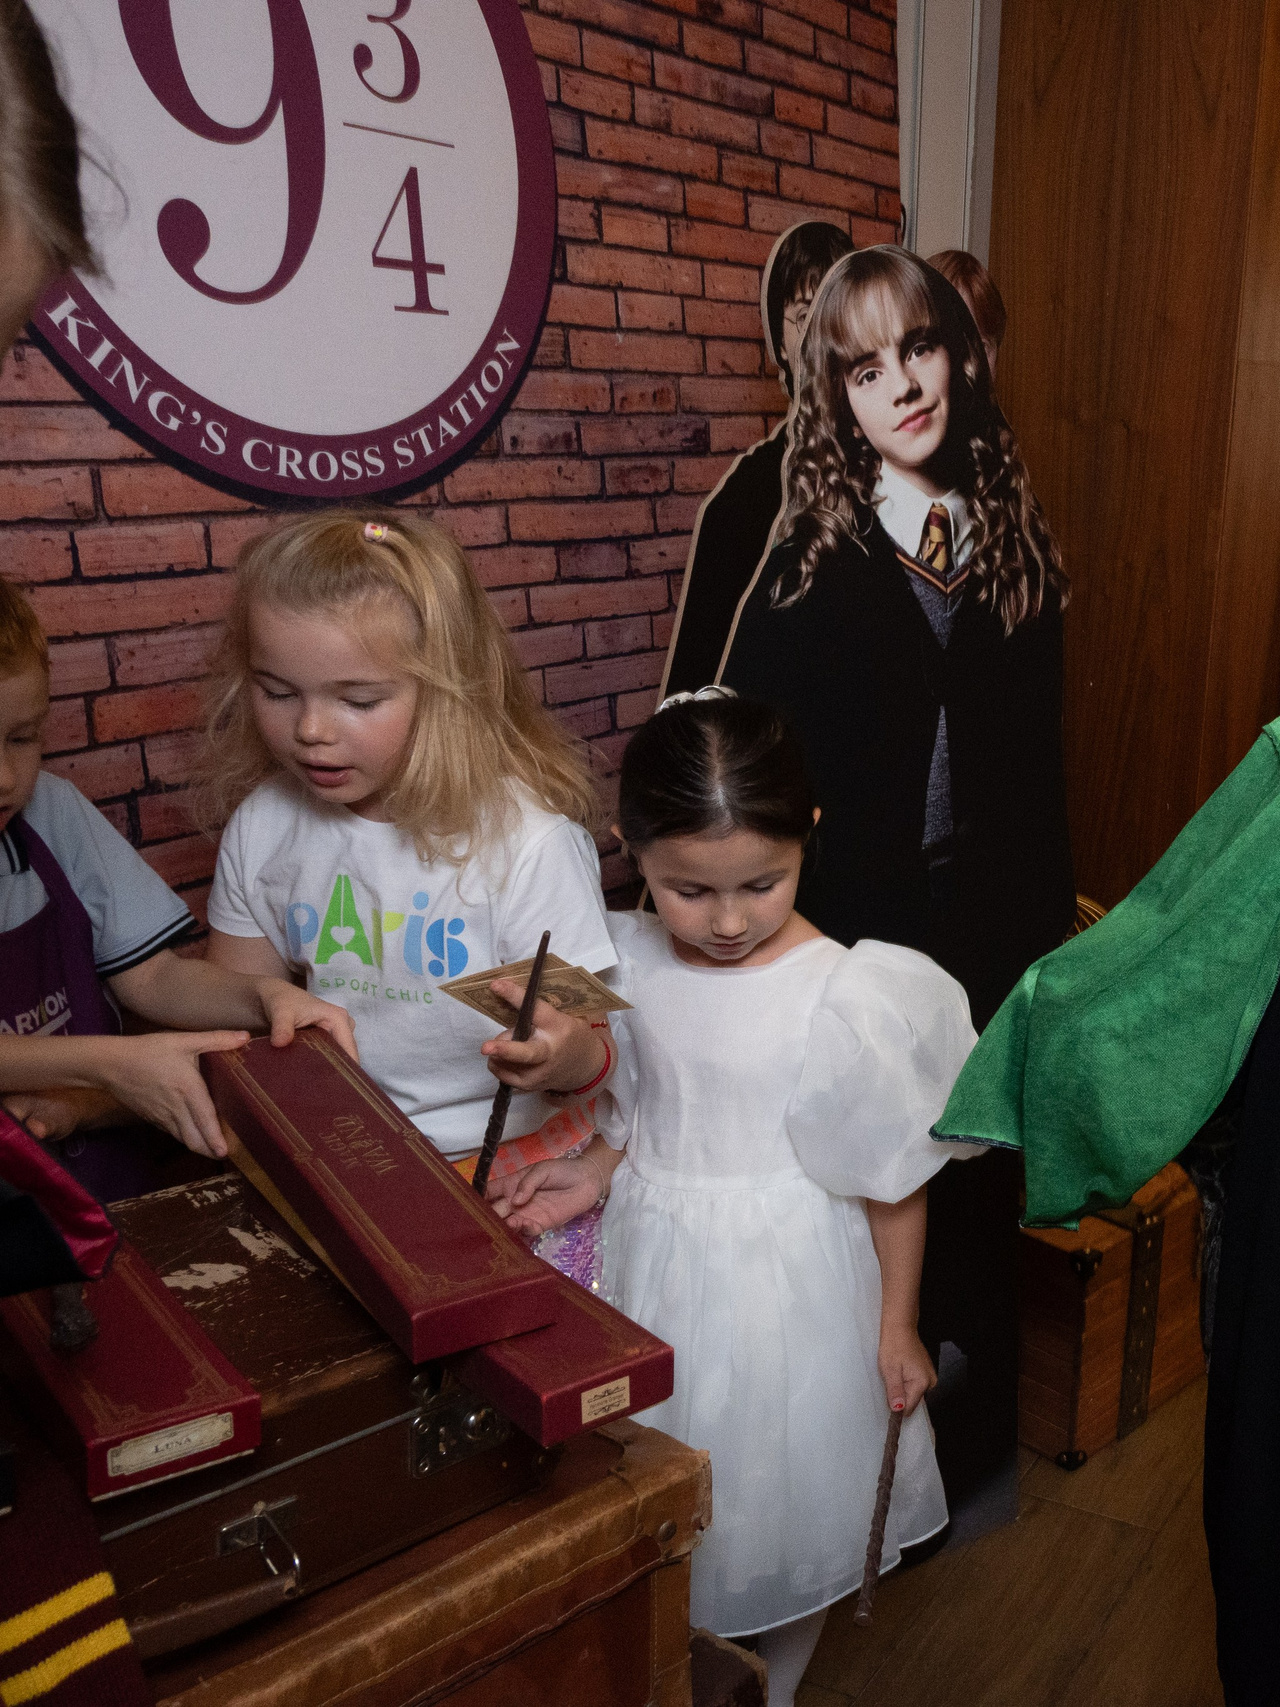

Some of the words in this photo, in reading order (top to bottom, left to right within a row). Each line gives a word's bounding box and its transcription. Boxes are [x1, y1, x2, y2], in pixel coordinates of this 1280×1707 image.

[117, 0, 326, 305] 9
[371, 166, 450, 316] 4
[44, 292, 229, 456] KING'S
[241, 438, 386, 482] CROSS
[393, 329, 522, 469] STATION
[319, 977, 378, 996] SPORT
[385, 986, 433, 1004] CHIC
